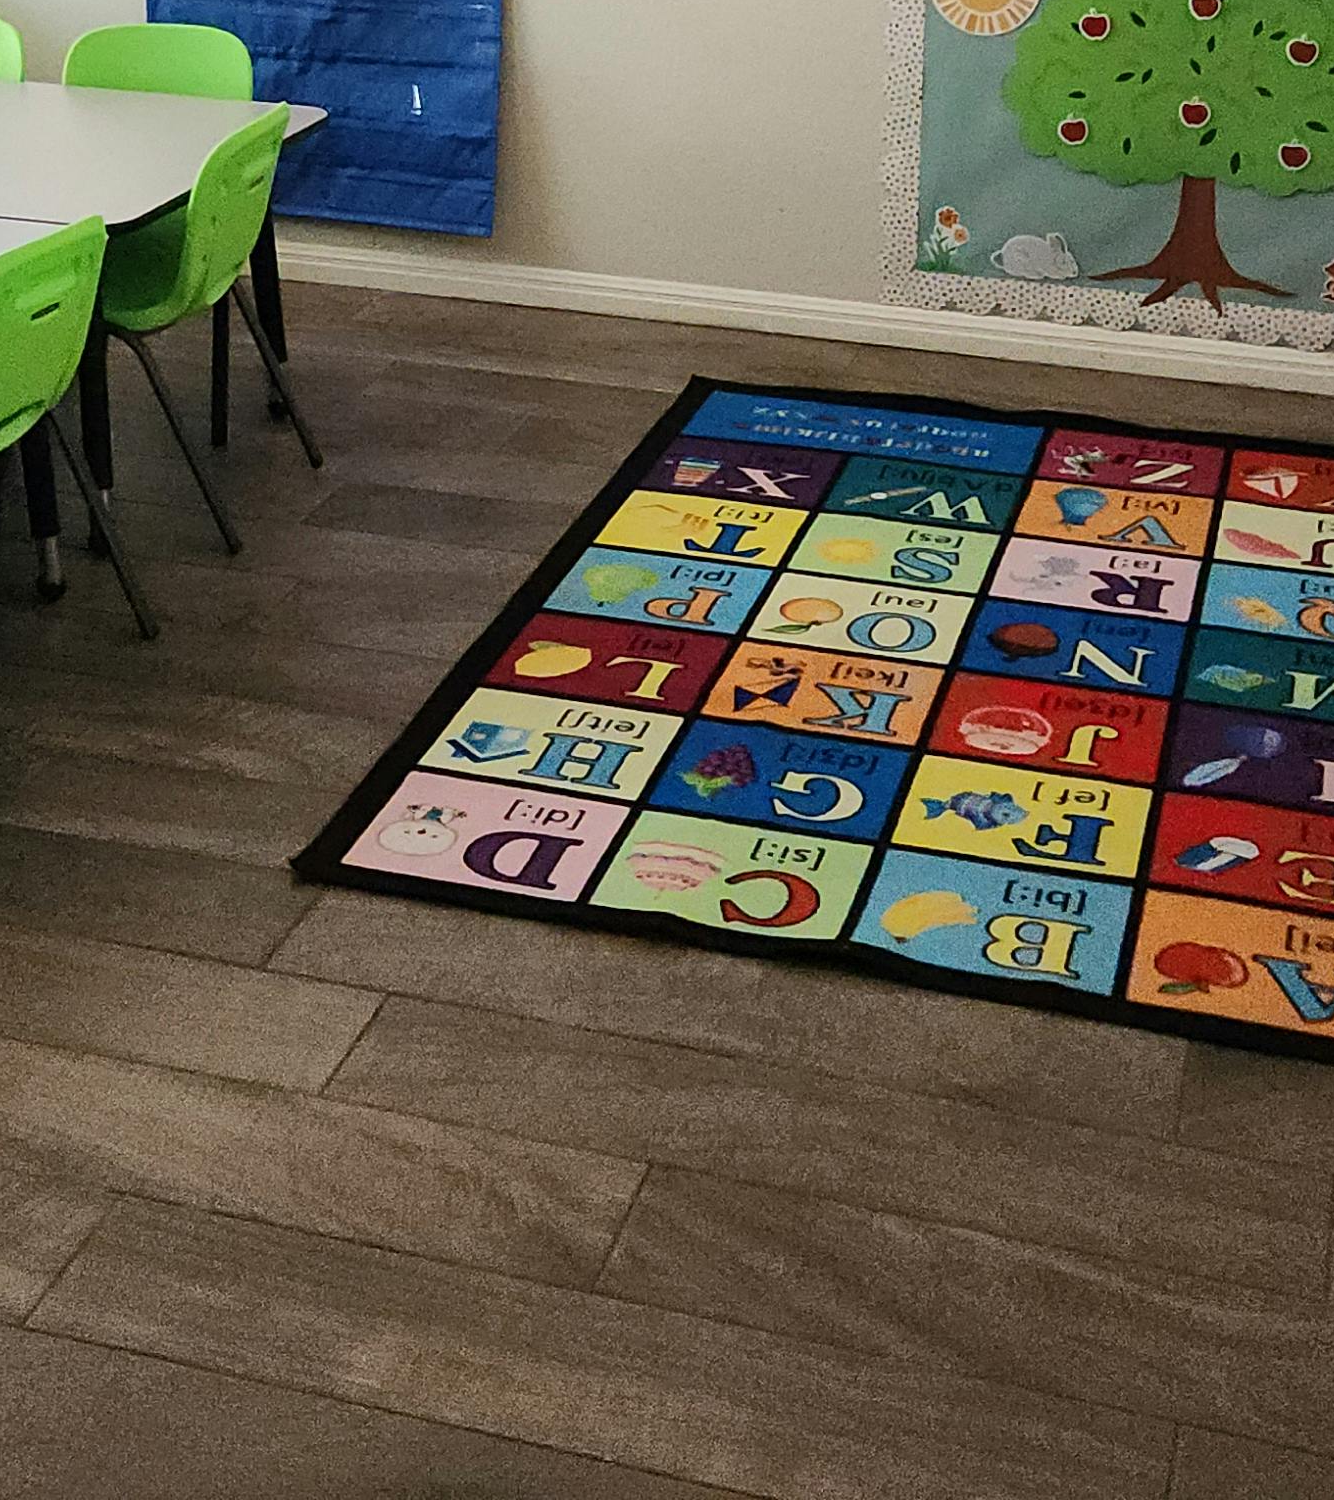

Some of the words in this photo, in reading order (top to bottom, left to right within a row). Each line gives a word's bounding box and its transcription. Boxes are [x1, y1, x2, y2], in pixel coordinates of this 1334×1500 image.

[726, 466, 811, 500] X
[1130, 458, 1195, 488] Z
[900, 490, 991, 526] W
[683, 522, 767, 559] T
[905, 528, 964, 549] [es]
[1098, 515, 1187, 551] V
[890, 546, 961, 584] S
[643, 585, 732, 627] P
[1090, 570, 1175, 614] R
[846, 611, 937, 653] O
[605, 655, 686, 701] L
[1060, 639, 1156, 688] N
[803, 682, 914, 737] K
[517, 732, 644, 790] H
[1053, 724, 1120, 768] J
[503, 799, 587, 832] [di:]
[770, 771, 864, 822] G
[462, 830, 585, 891] D
[750, 838, 827, 872] [si:]
[1011, 812, 1116, 867] F
[719, 869, 821, 928] C
[1002, 878, 1090, 917] [bi:]
[982, 913, 1093, 982] B
